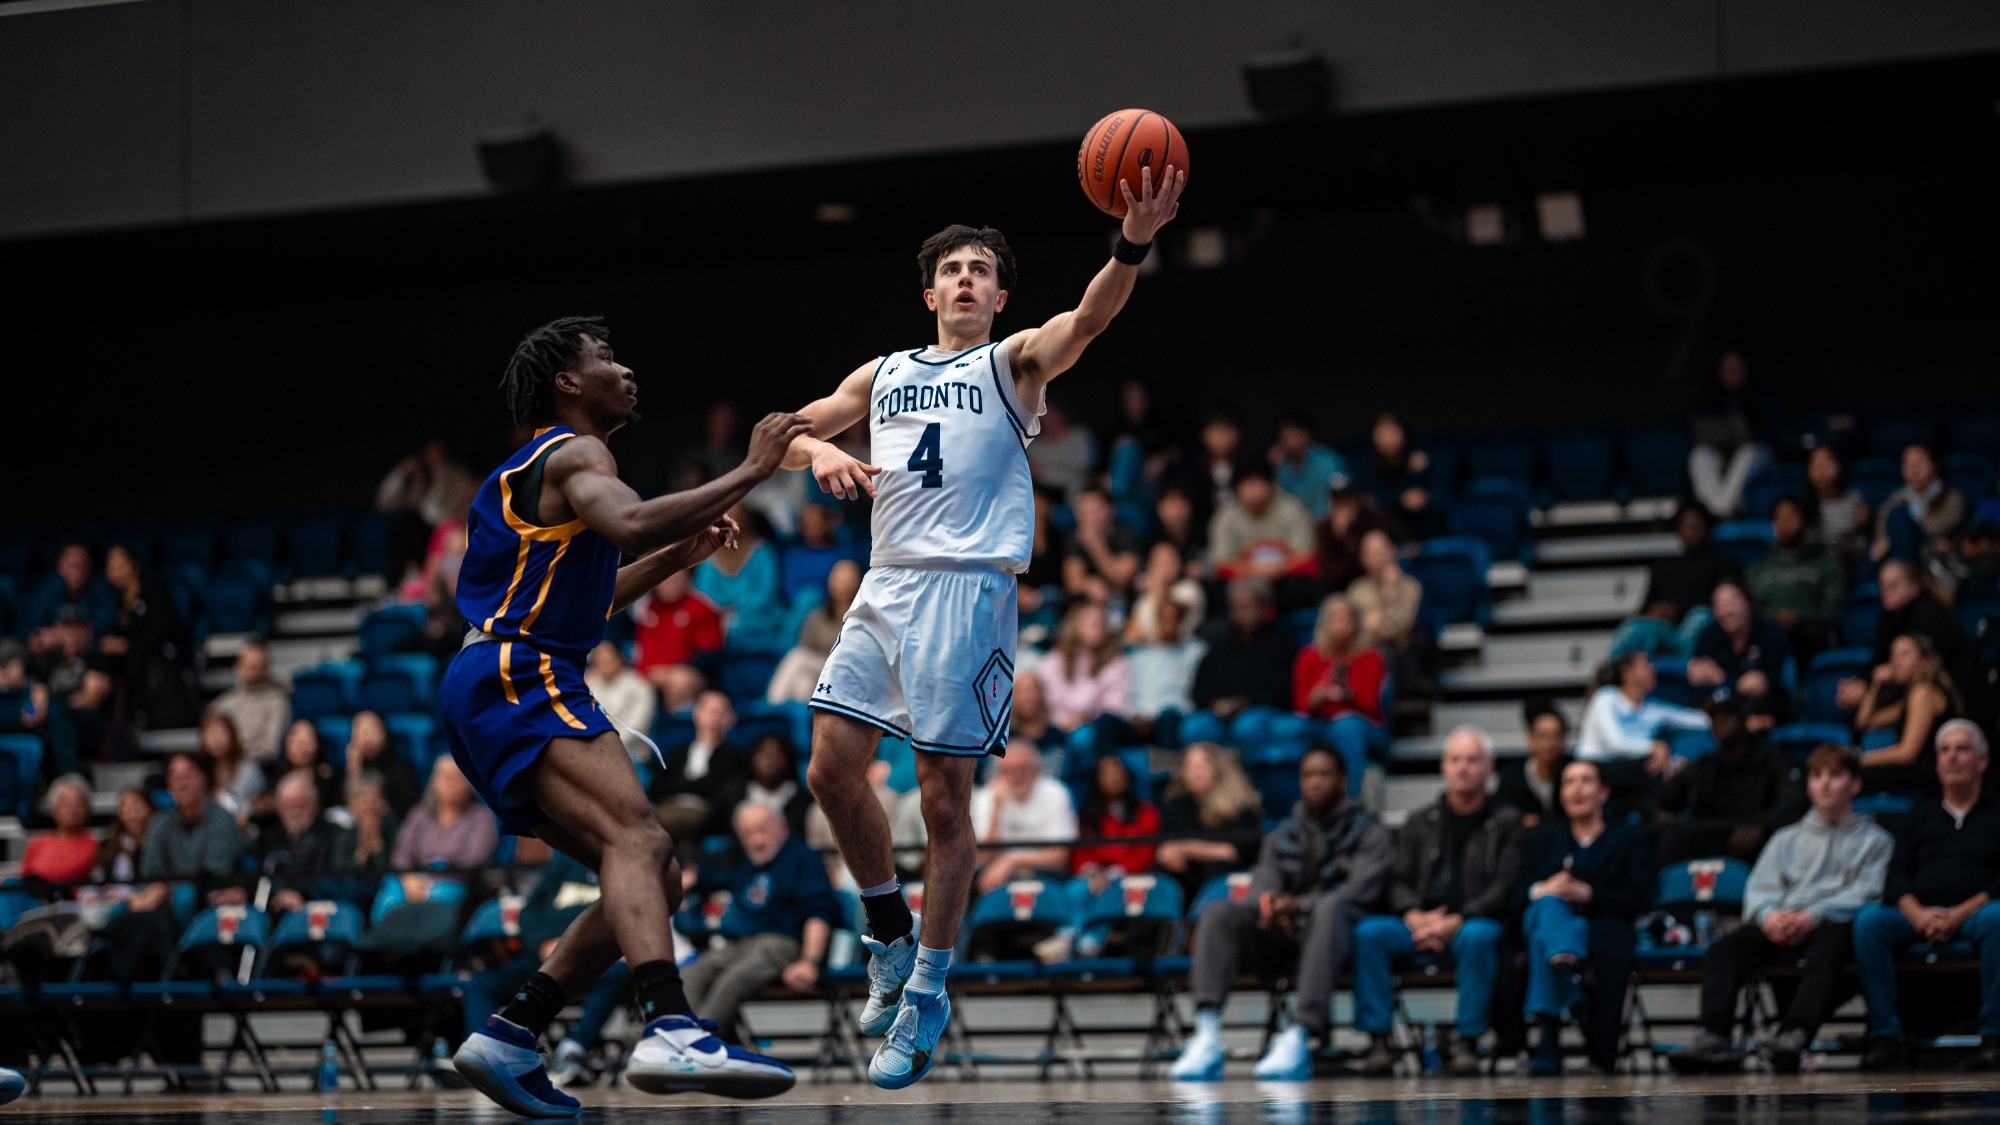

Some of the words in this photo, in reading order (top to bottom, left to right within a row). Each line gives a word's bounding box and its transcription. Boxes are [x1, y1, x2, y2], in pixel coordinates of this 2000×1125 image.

[1094, 117, 1123, 182] EVOLUTION
[877, 381, 984, 425] TORONTO
[907, 422, 943, 489] 4
